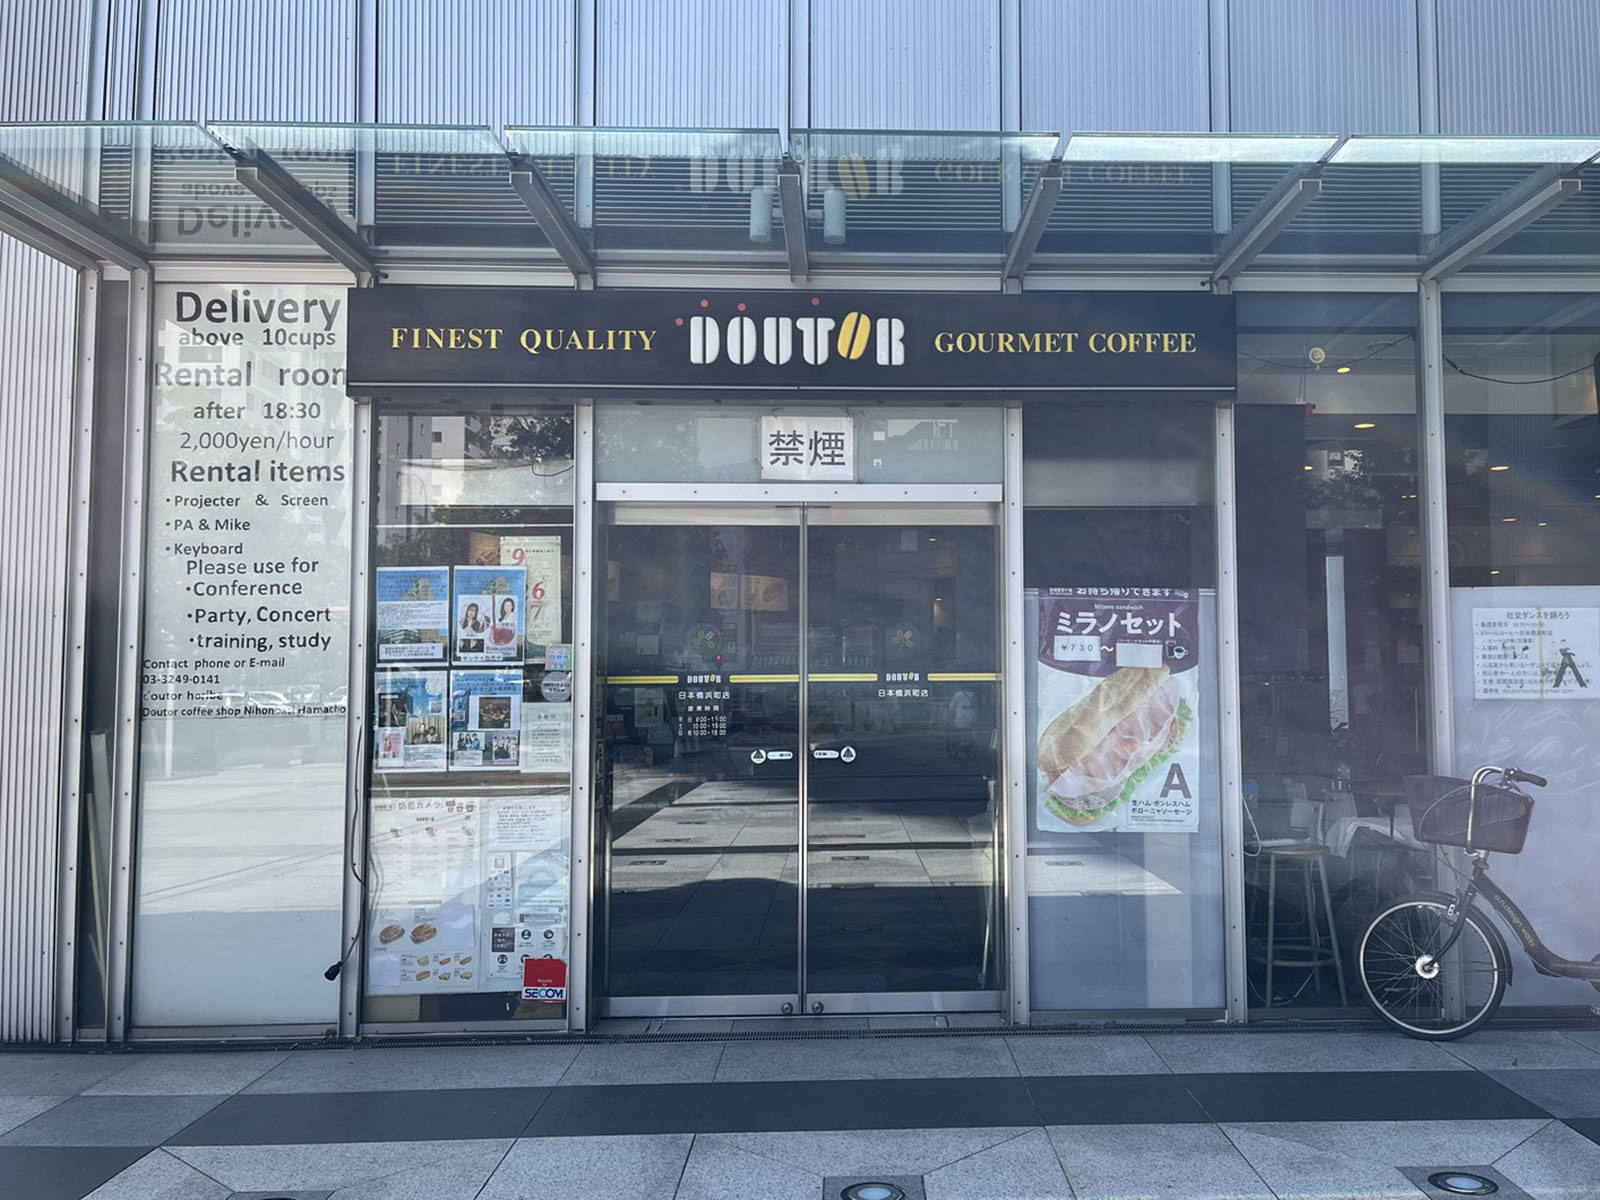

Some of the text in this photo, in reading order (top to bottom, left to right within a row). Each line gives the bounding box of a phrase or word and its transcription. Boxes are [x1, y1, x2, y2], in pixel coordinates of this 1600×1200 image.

[175, 289, 341, 331] Delivery
[178, 327, 336, 350] above 10cups
[391, 327, 657, 355] FINEST QUALITY
[690, 311, 905, 366] DOUTOR
[934, 332, 1197, 354] GOURMET COFFEE
[155, 360, 252, 387] Rental
[193, 401, 322, 419] after 18:30
[179, 430, 335, 453] 2,000yen/hour
[768, 430, 846, 467] 禁煙
[171, 459, 345, 483] Rental items
[174, 493, 329, 509] Projecter & Screen
[173, 518, 251, 531] PA & Mike
[173, 542, 244, 557] Keyboard
[186, 556, 319, 575] Please use for
[193, 580, 303, 597] Conference
[194, 605, 332, 626] Party, Concert
[1056, 611, 1182, 638] ミラノセット
[196, 631, 332, 653] training, study
[142, 656, 285, 671] Contact phone or E-mail
[142, 674, 220, 685] 03-3249-0141
[142, 706, 179, 718] Doutor
[181, 705, 213, 717] coffee
[215, 705, 241, 718] shop
[1159, 762, 1193, 799] A
[524, 988, 564, 999] SECOM
